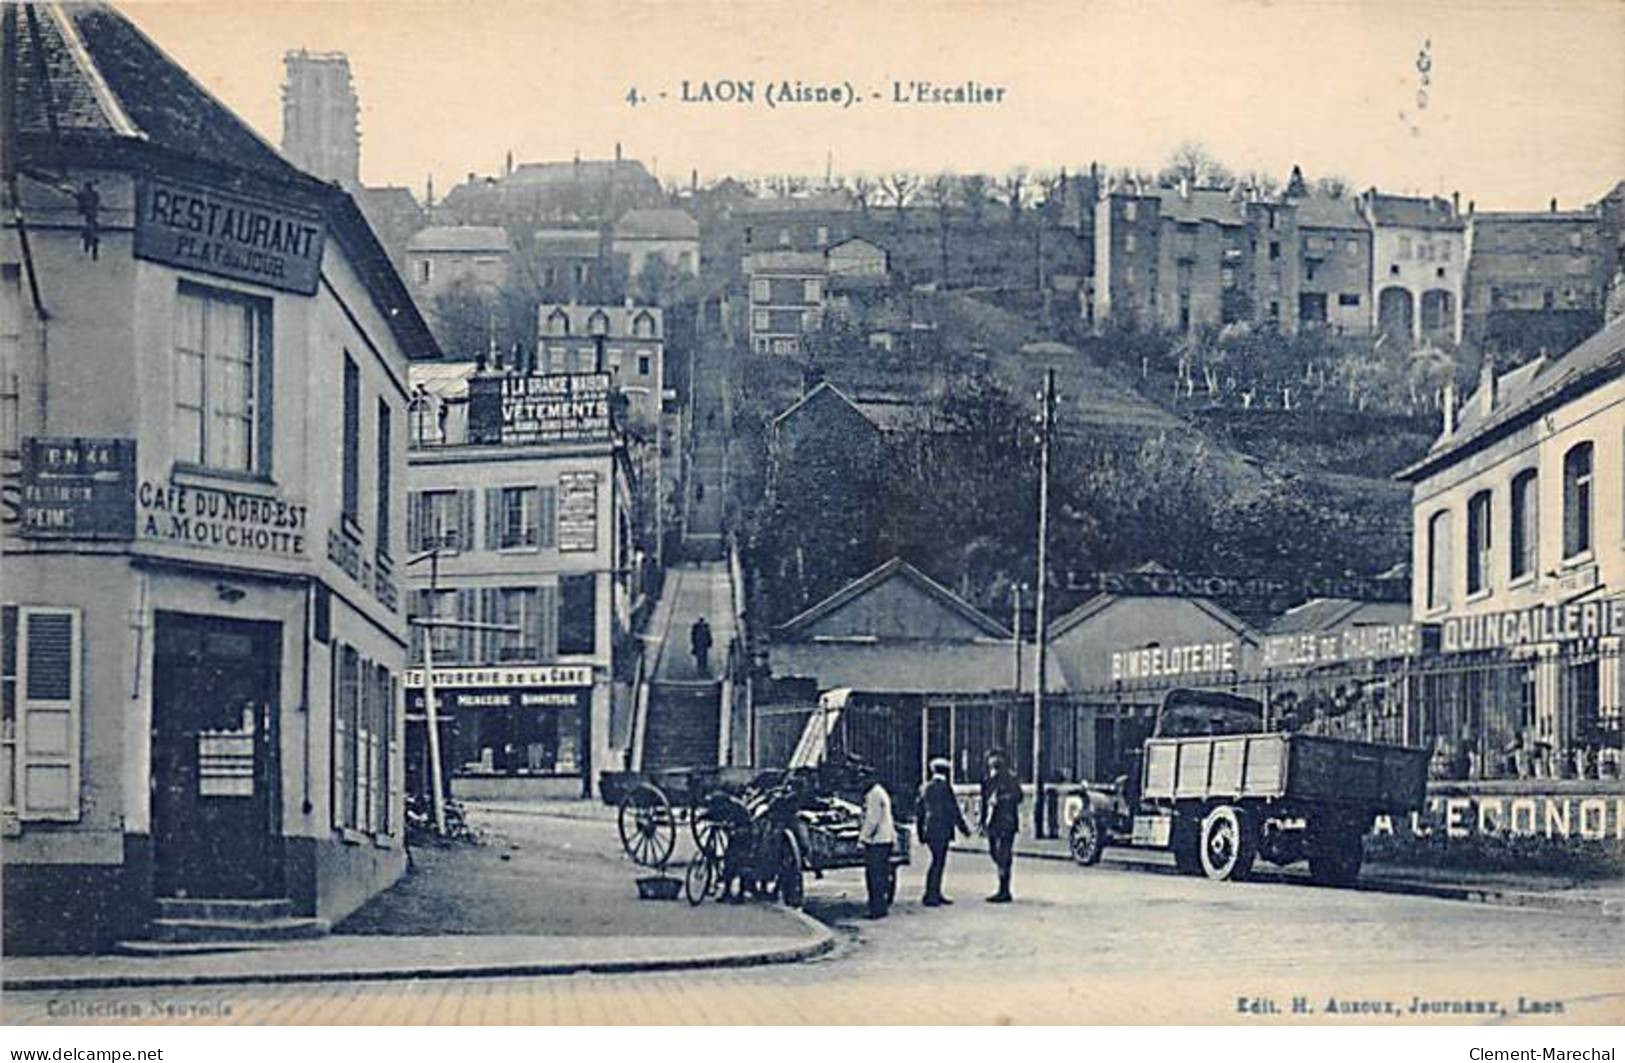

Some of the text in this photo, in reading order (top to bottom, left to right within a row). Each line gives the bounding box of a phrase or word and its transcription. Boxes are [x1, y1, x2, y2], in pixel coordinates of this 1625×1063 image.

[152, 189, 317, 259] RESTAURANT
[176, 236, 223, 264] PLAT
[511, 379, 525, 395] LA
[196, 492, 219, 518] DU
[224, 492, 307, 530] NORD-EST
[170, 516, 304, 554] MOUCHOTTE
[1444, 601, 1625, 652] QUINCAILLERIE
[405, 671, 500, 686] TENTURERIE
[507, 673, 524, 684] DE
[530, 672, 547, 683] LA
[1112, 642, 1234, 681] BIMBELOTERIE
[1373, 815, 1394, 836] A
